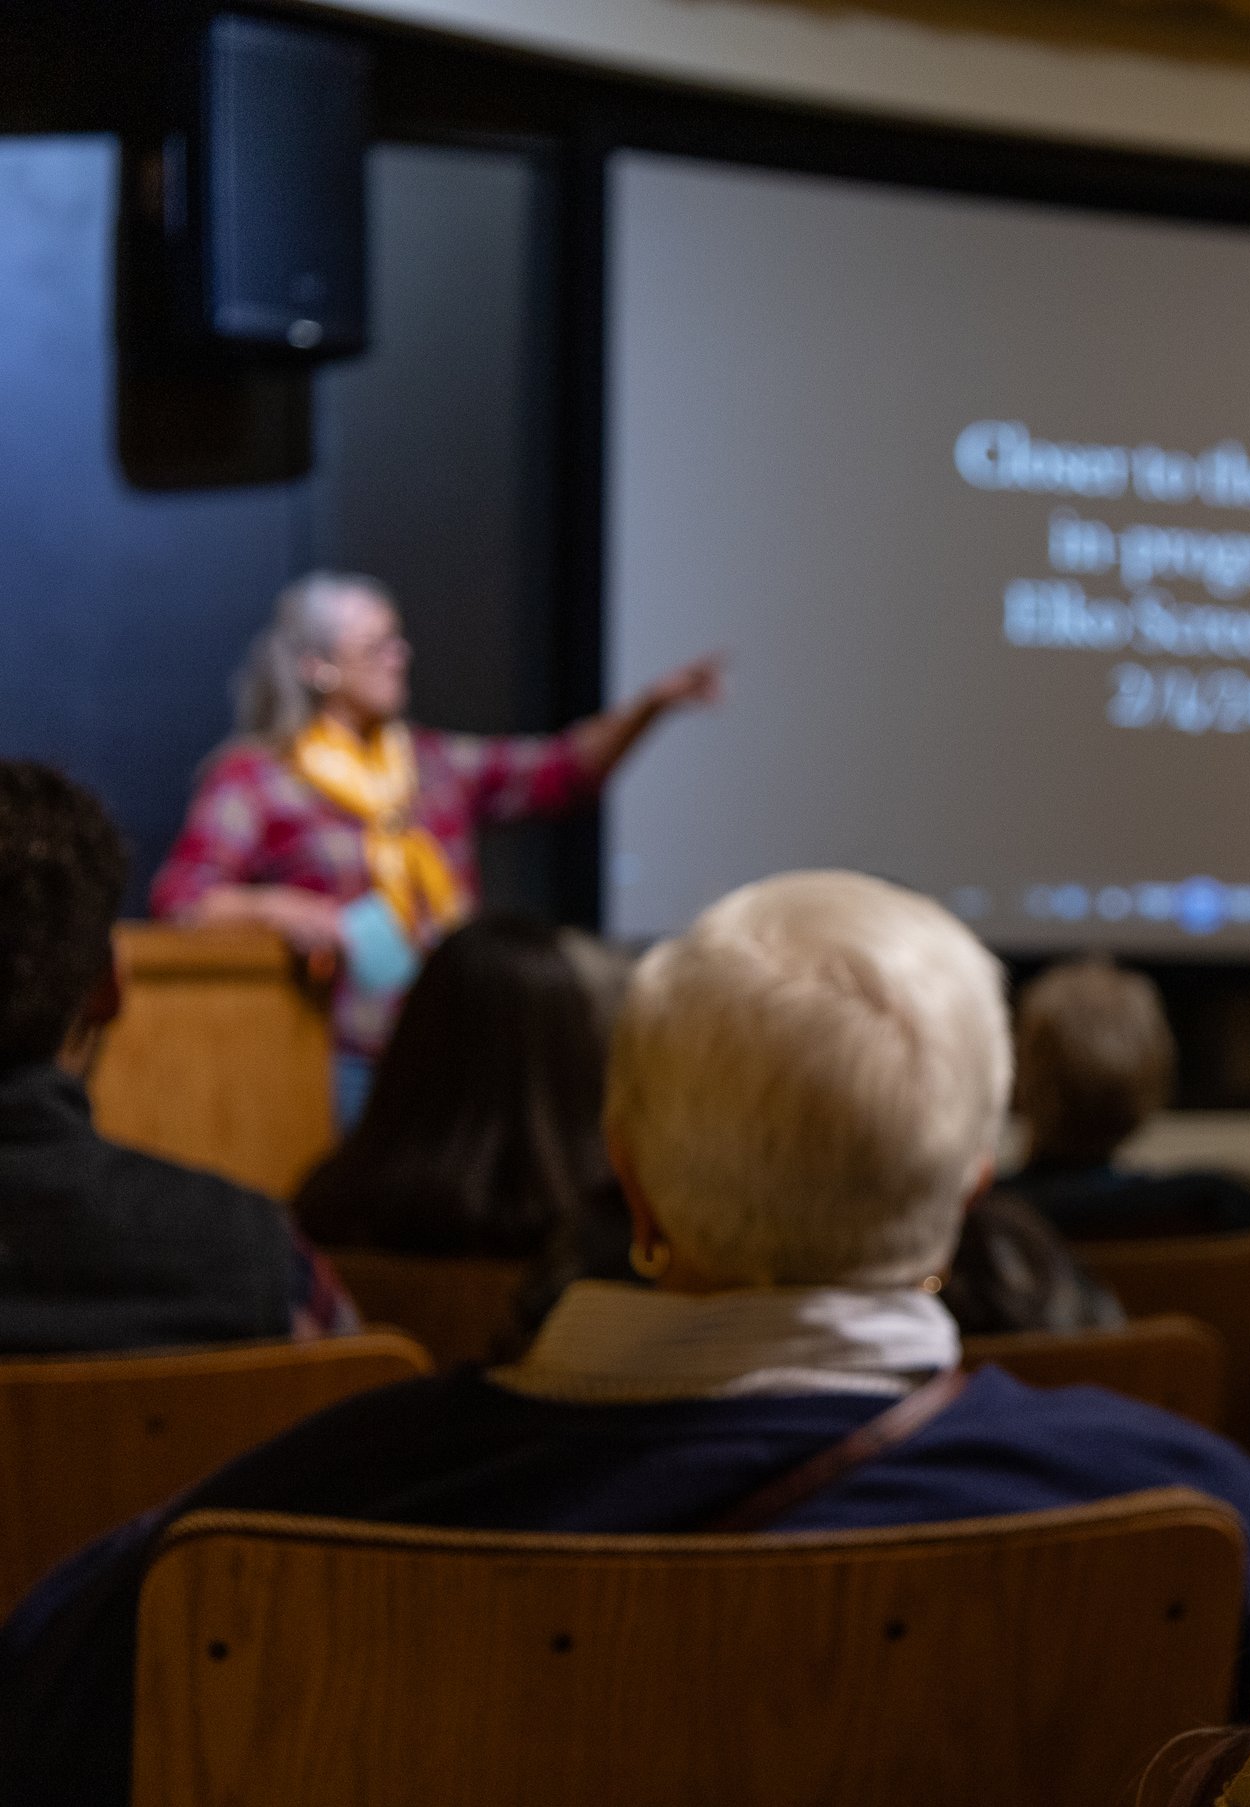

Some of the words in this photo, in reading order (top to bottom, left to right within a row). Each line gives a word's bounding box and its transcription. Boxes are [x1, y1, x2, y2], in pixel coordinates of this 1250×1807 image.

[955, 420, 1128, 499] Closer
[1131, 442, 1196, 504] to
[1005, 579, 1133, 650] Elko
